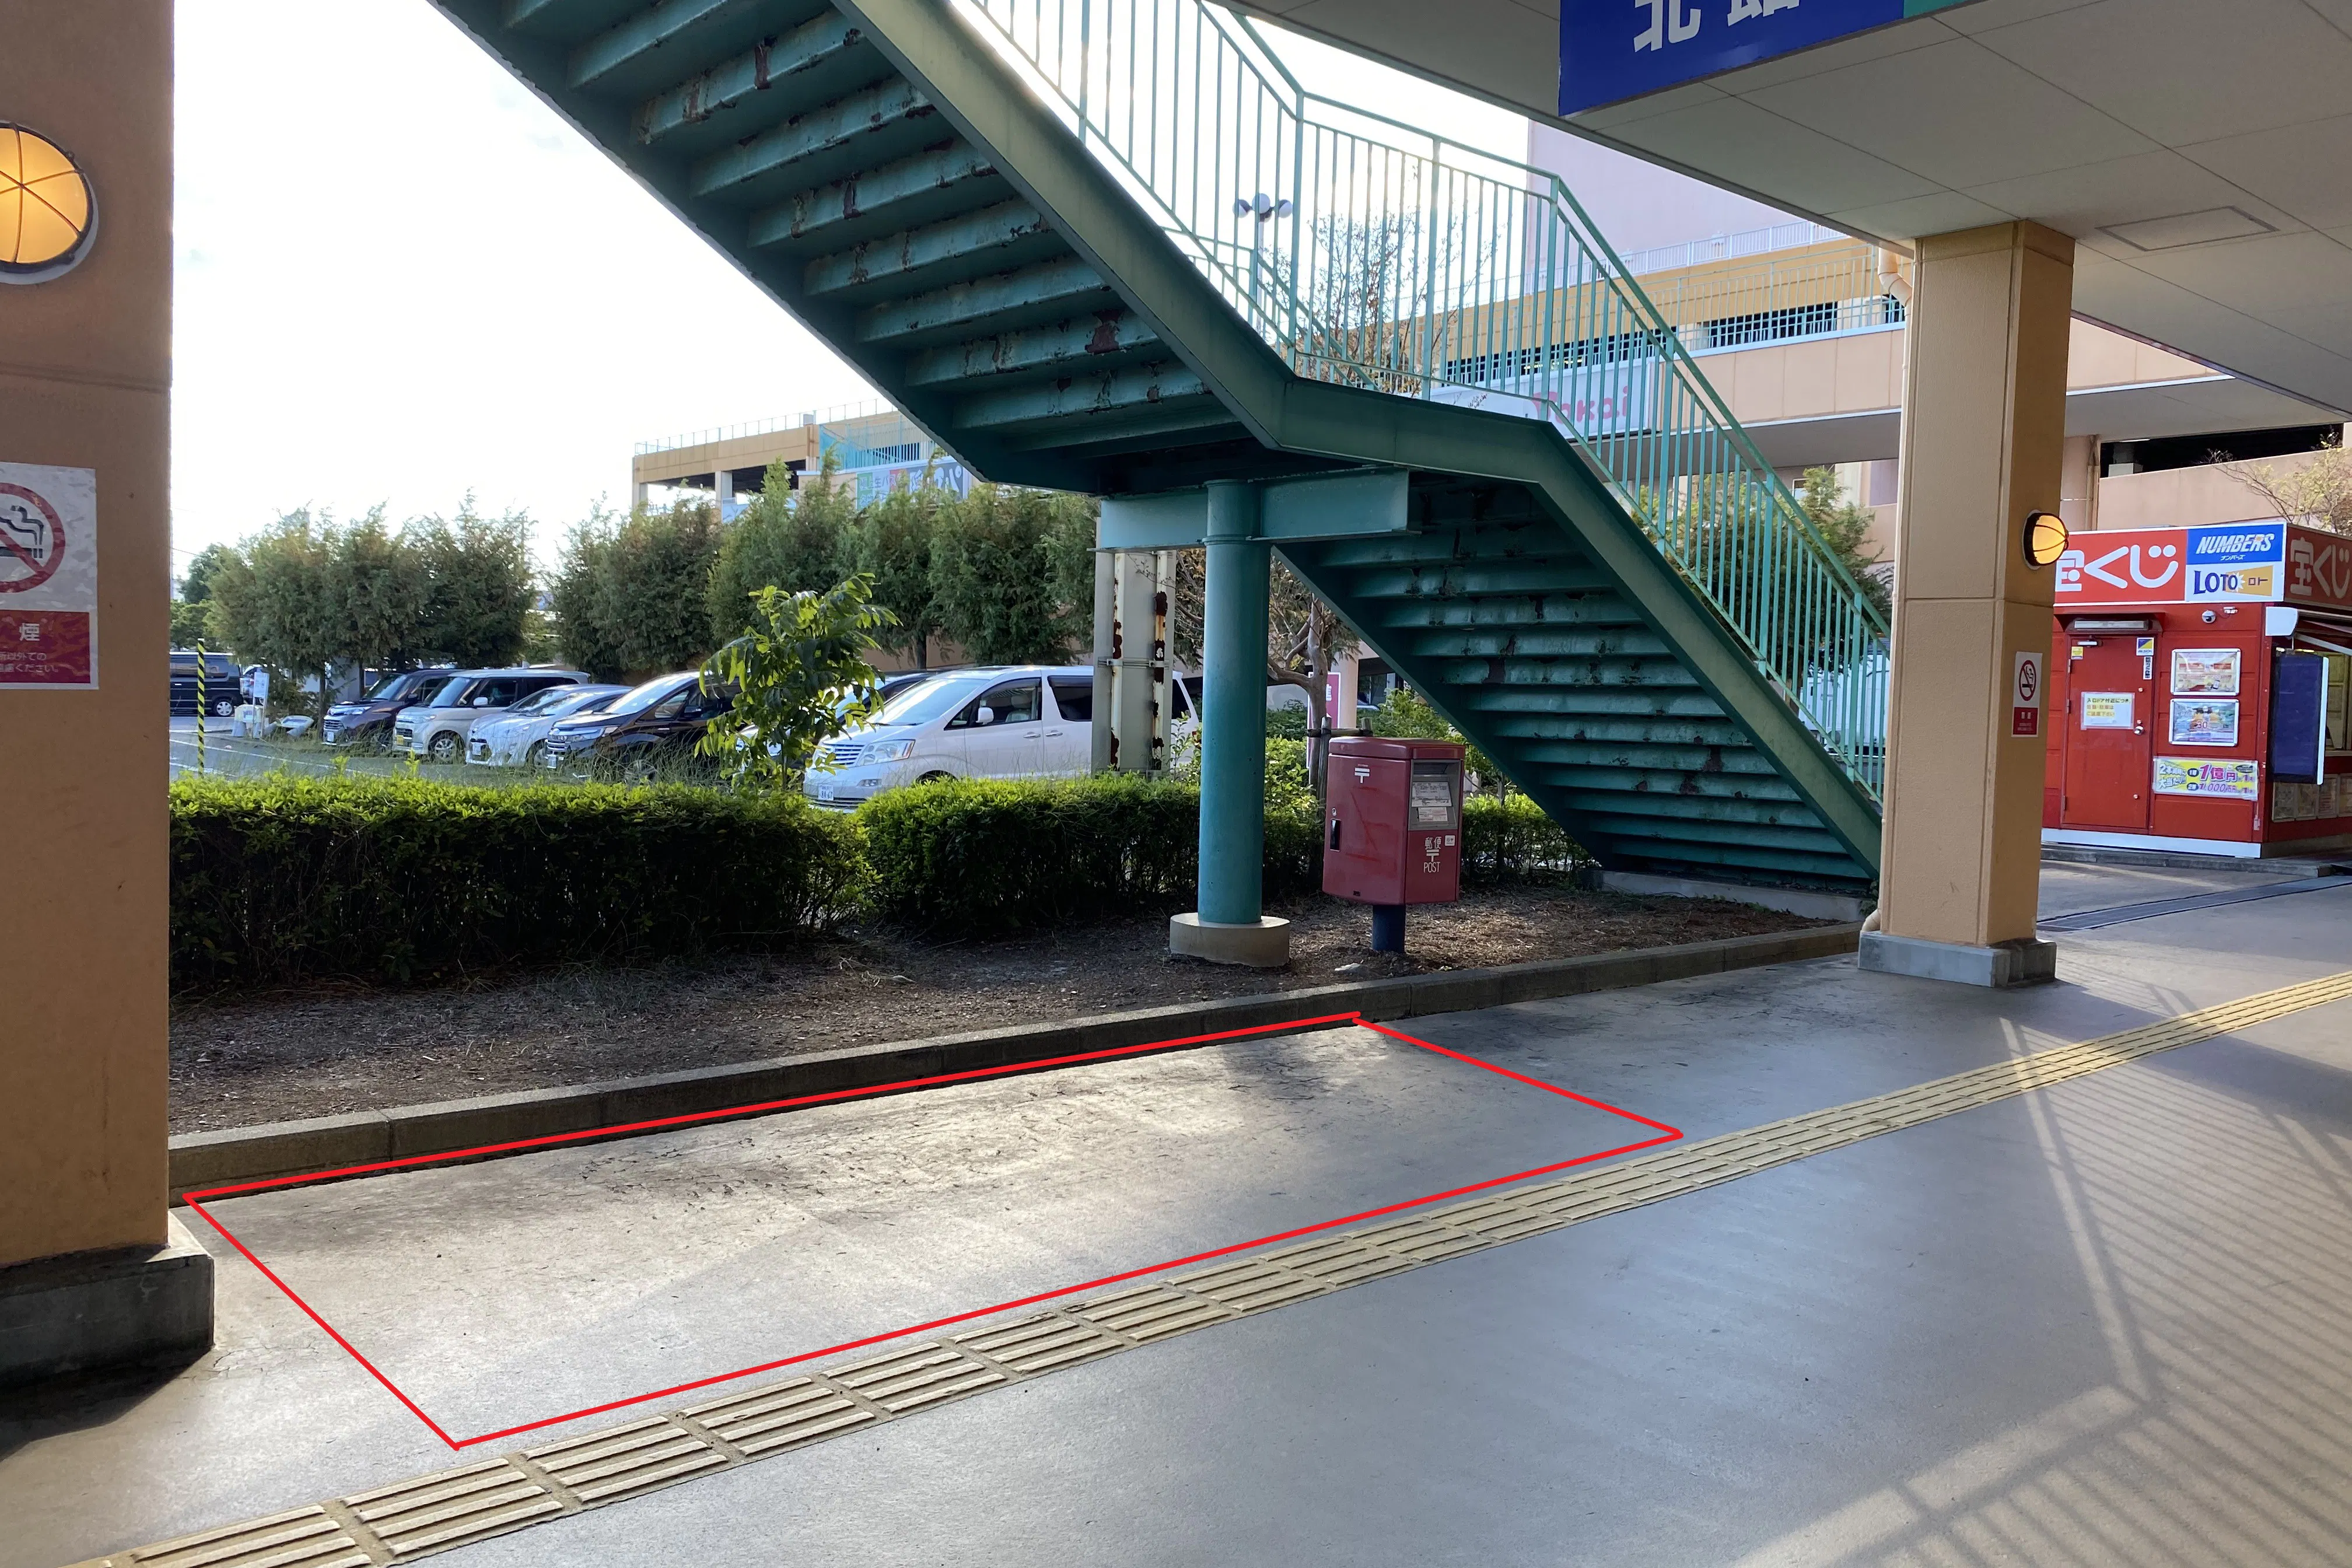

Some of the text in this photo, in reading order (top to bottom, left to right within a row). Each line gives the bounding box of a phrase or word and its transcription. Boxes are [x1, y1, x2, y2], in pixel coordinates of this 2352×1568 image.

[2196, 533, 2275, 554] NUMBERS
[2290, 537, 2351, 599] 宝くじ
[2193, 569, 2238, 594] LOTO
[2248, 576, 2269, 586] ロト
[19, 623, 40, 641] 煙
[1424, 836, 1442, 850] 郵便
[1423, 862, 1440, 873] POST
